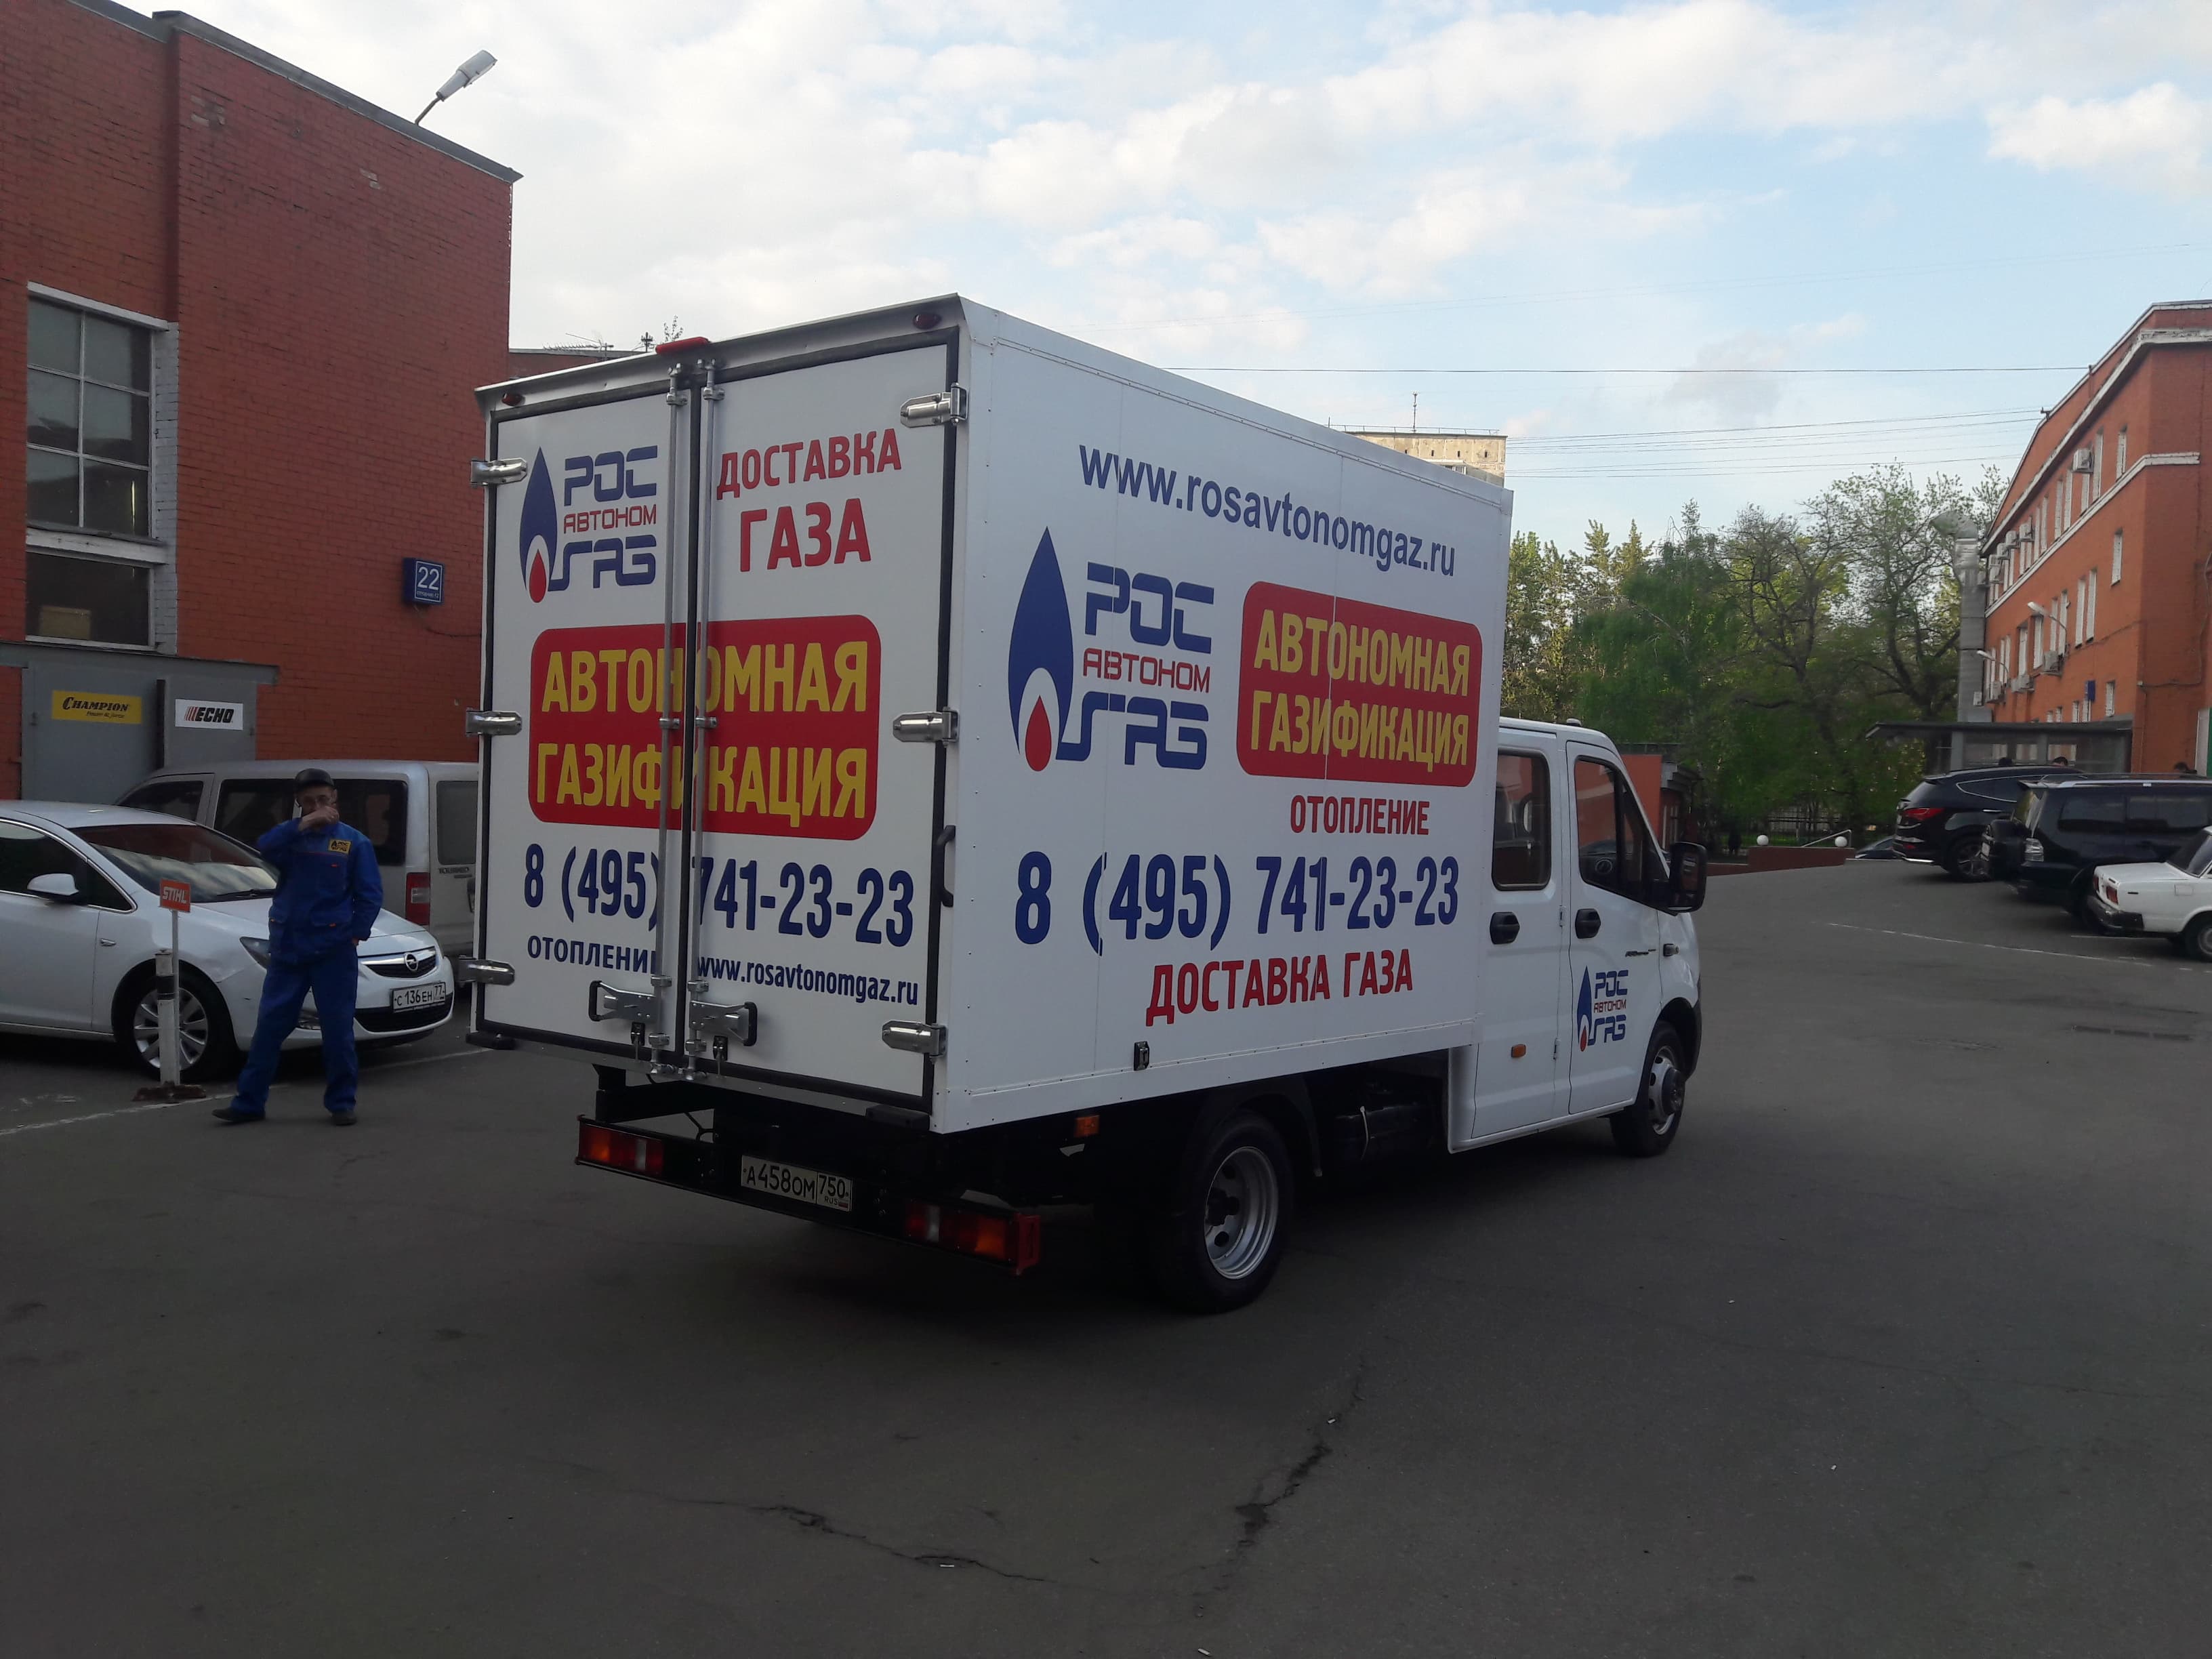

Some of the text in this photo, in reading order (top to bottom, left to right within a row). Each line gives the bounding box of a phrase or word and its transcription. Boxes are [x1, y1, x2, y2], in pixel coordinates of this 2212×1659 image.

[564, 445, 657, 506] РОС
[716, 428, 901, 499] ДОСТАВКА
[564, 504, 657, 533] АВТОНОМ
[741, 498, 871, 571] ГАЗА
[1080, 445, 1455, 577] www.rosavtonomgaz.ru
[417, 567, 439, 590] 22
[1085, 561, 1214, 654] РОС
[1084, 648, 1210, 693] АВТОНОМ
[1254, 610, 1469, 696] АВТОНОМНАЯ
[195, 707, 234, 723] ECHO
[1252, 691, 1468, 773] ГАЗИФИКАЦИЯ
[1291, 795, 1430, 836] ОТОПЛЕНИЕ
[163, 886, 186, 903] STIHL
[525, 844, 914, 947] 8 (495) 741-23-23
[1015, 851, 1458, 956] 8 (495) 741-23-23
[697, 956, 918, 1005] www.rosavtonomgaz.ru
[1146, 949, 1413, 1026] ДОСТАВКА ГАЗА
[1594, 1000, 1626, 1013] АВТОНОМ
[1595, 970, 1629, 999] РОС
[824, 1195, 838, 1206] RUS
